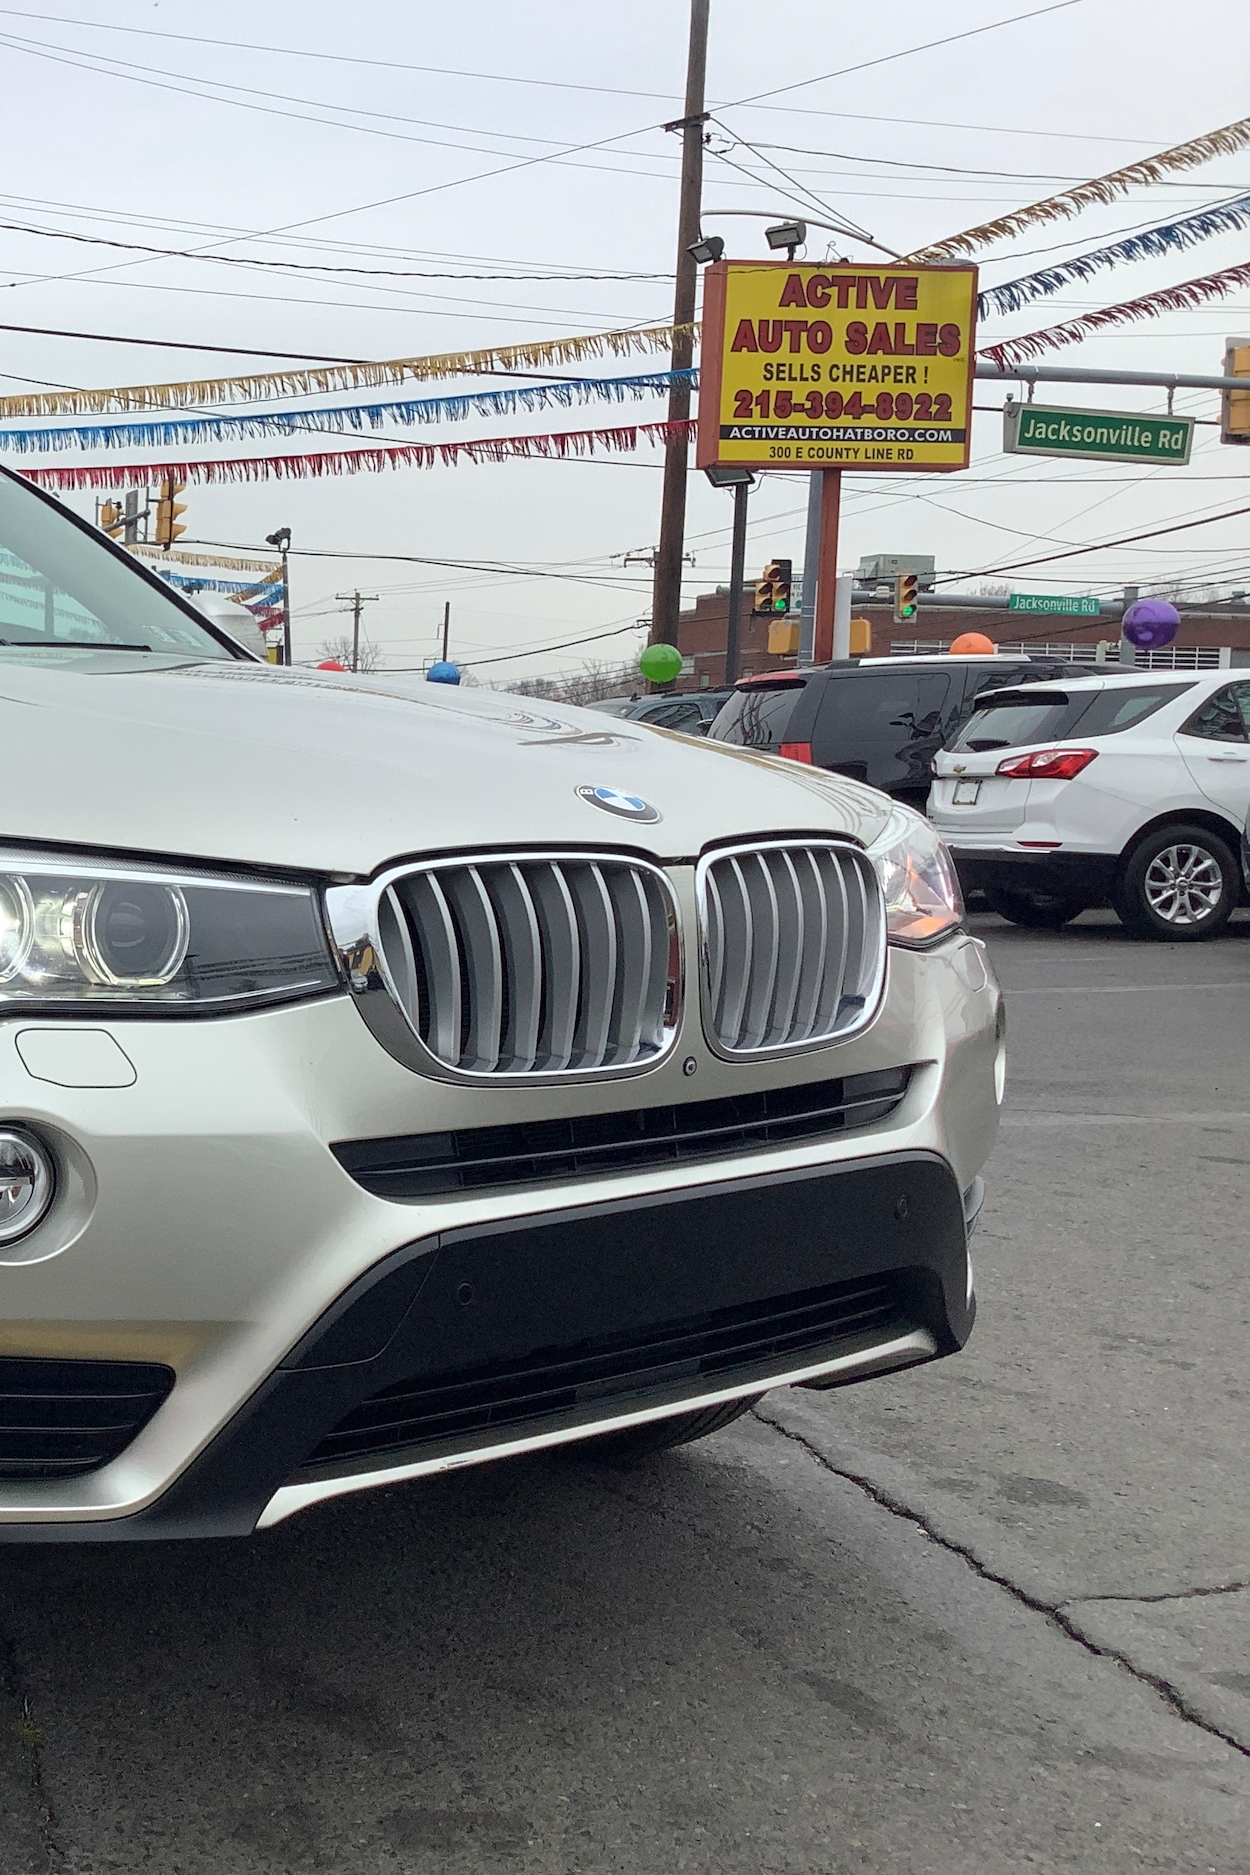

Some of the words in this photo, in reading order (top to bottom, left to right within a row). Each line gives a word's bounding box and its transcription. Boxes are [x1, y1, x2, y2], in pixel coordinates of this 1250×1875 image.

[778, 274, 919, 310] ACTIVE
[730, 319, 833, 354] AUTO
[844, 321, 962, 357] SALES
[762, 362, 822, 382] SELLS
[828, 364, 917, 384] CHEAPER
[732, 389, 953, 422] 215-394-8922
[729, 426, 952, 442] ACTIVEAUTOHATBORO.COM
[1024, 419, 1153, 448] Jacksonville
[1157, 430, 1184, 450] Rd
[769, 446, 791, 459] 300
[795, 447, 804, 459] E
[807, 447, 861, 460] COUNTY
[865, 447, 894, 460] LINE
[898, 447, 914, 460] RD
[1014, 596, 1079, 612] Jacksonville
[1081, 600, 1095, 613] Rd
